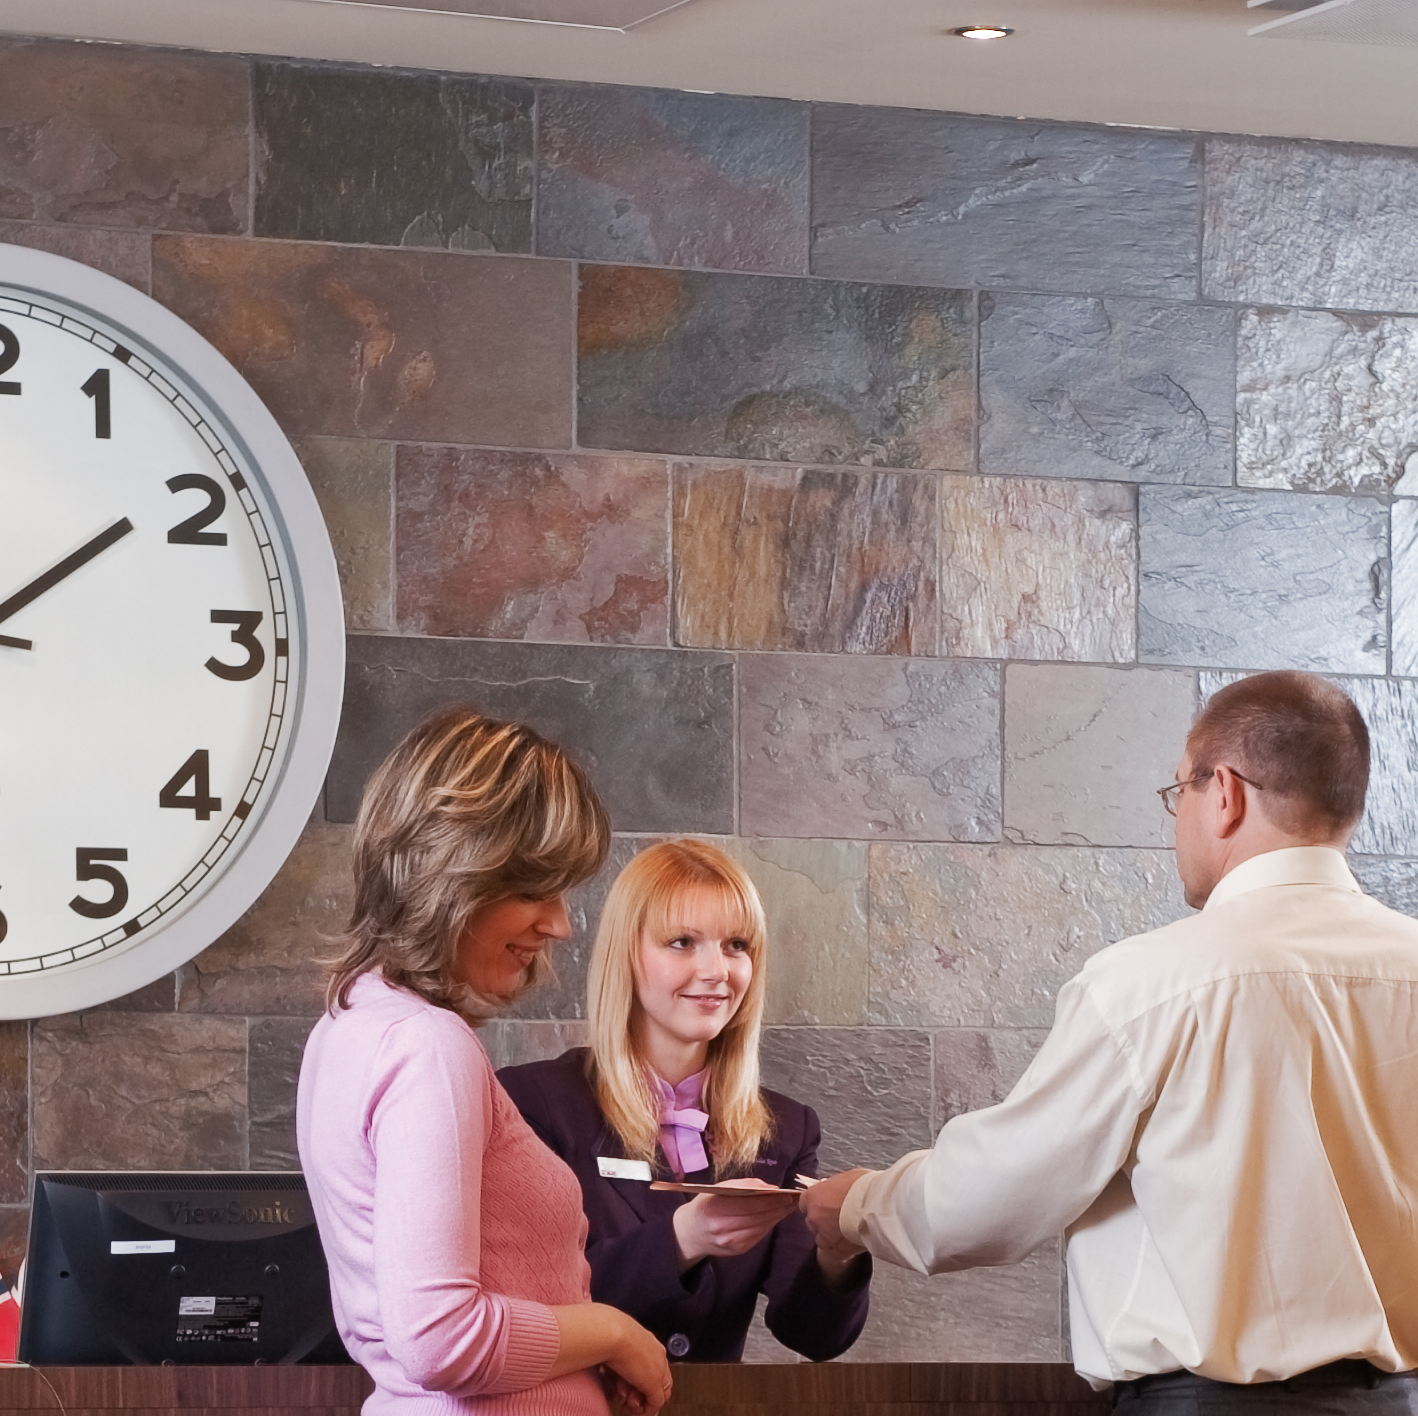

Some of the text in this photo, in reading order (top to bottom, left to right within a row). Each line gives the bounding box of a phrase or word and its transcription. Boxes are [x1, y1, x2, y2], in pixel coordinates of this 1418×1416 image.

[80, 368, 112, 440] 1
[164, 473, 228, 547] 2
[204, 609, 266, 682] 3
[158, 748, 223, 822] 4
[68, 846, 129, 920] 5
[161, 1200, 297, 1225] ViewSonic
